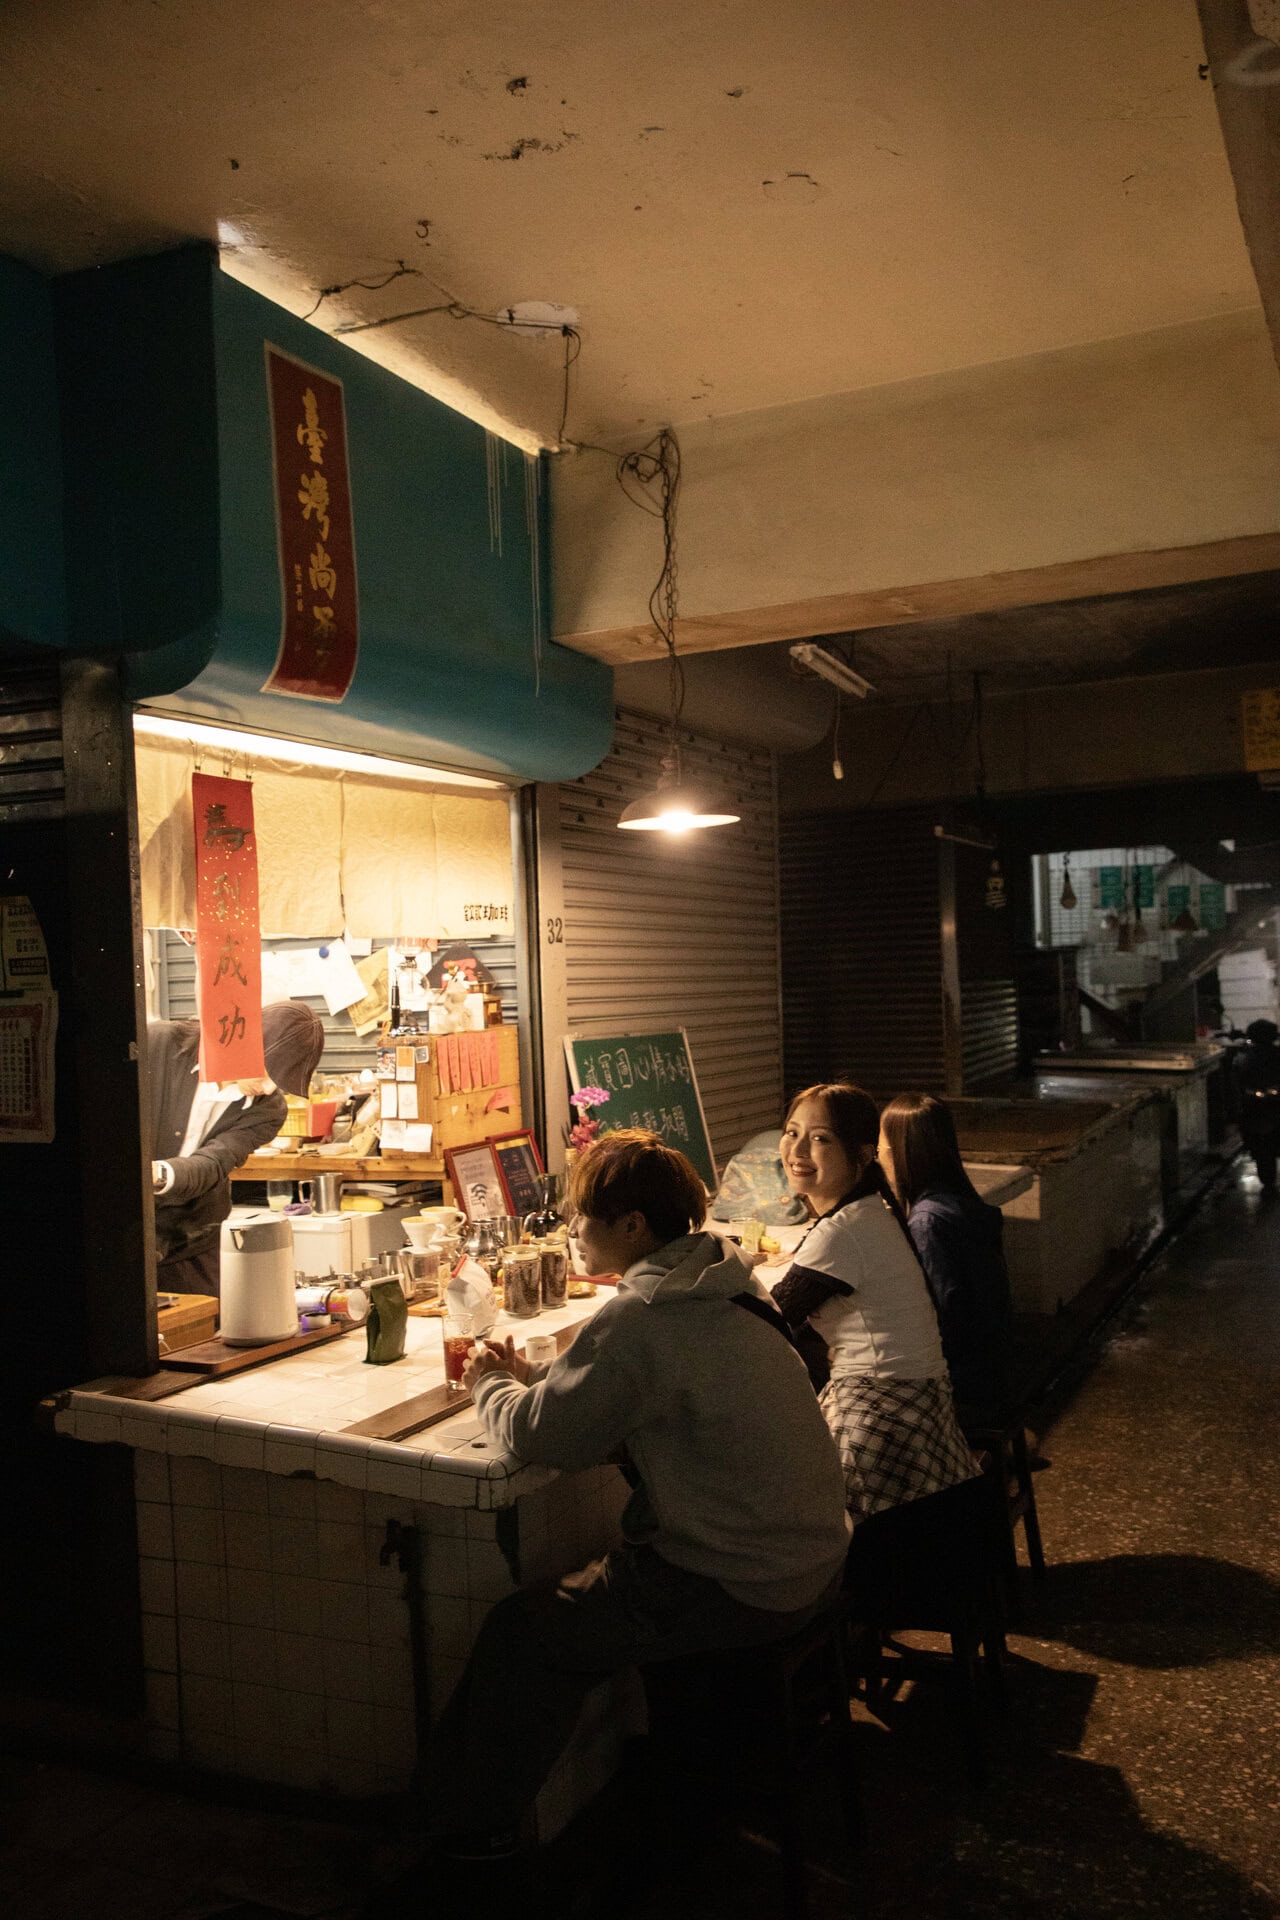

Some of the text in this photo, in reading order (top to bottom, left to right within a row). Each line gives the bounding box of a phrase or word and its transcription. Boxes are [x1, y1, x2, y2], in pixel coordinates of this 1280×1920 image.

[202, 803, 253, 1049] 馬到成功
[547, 917, 563, 944] 32
